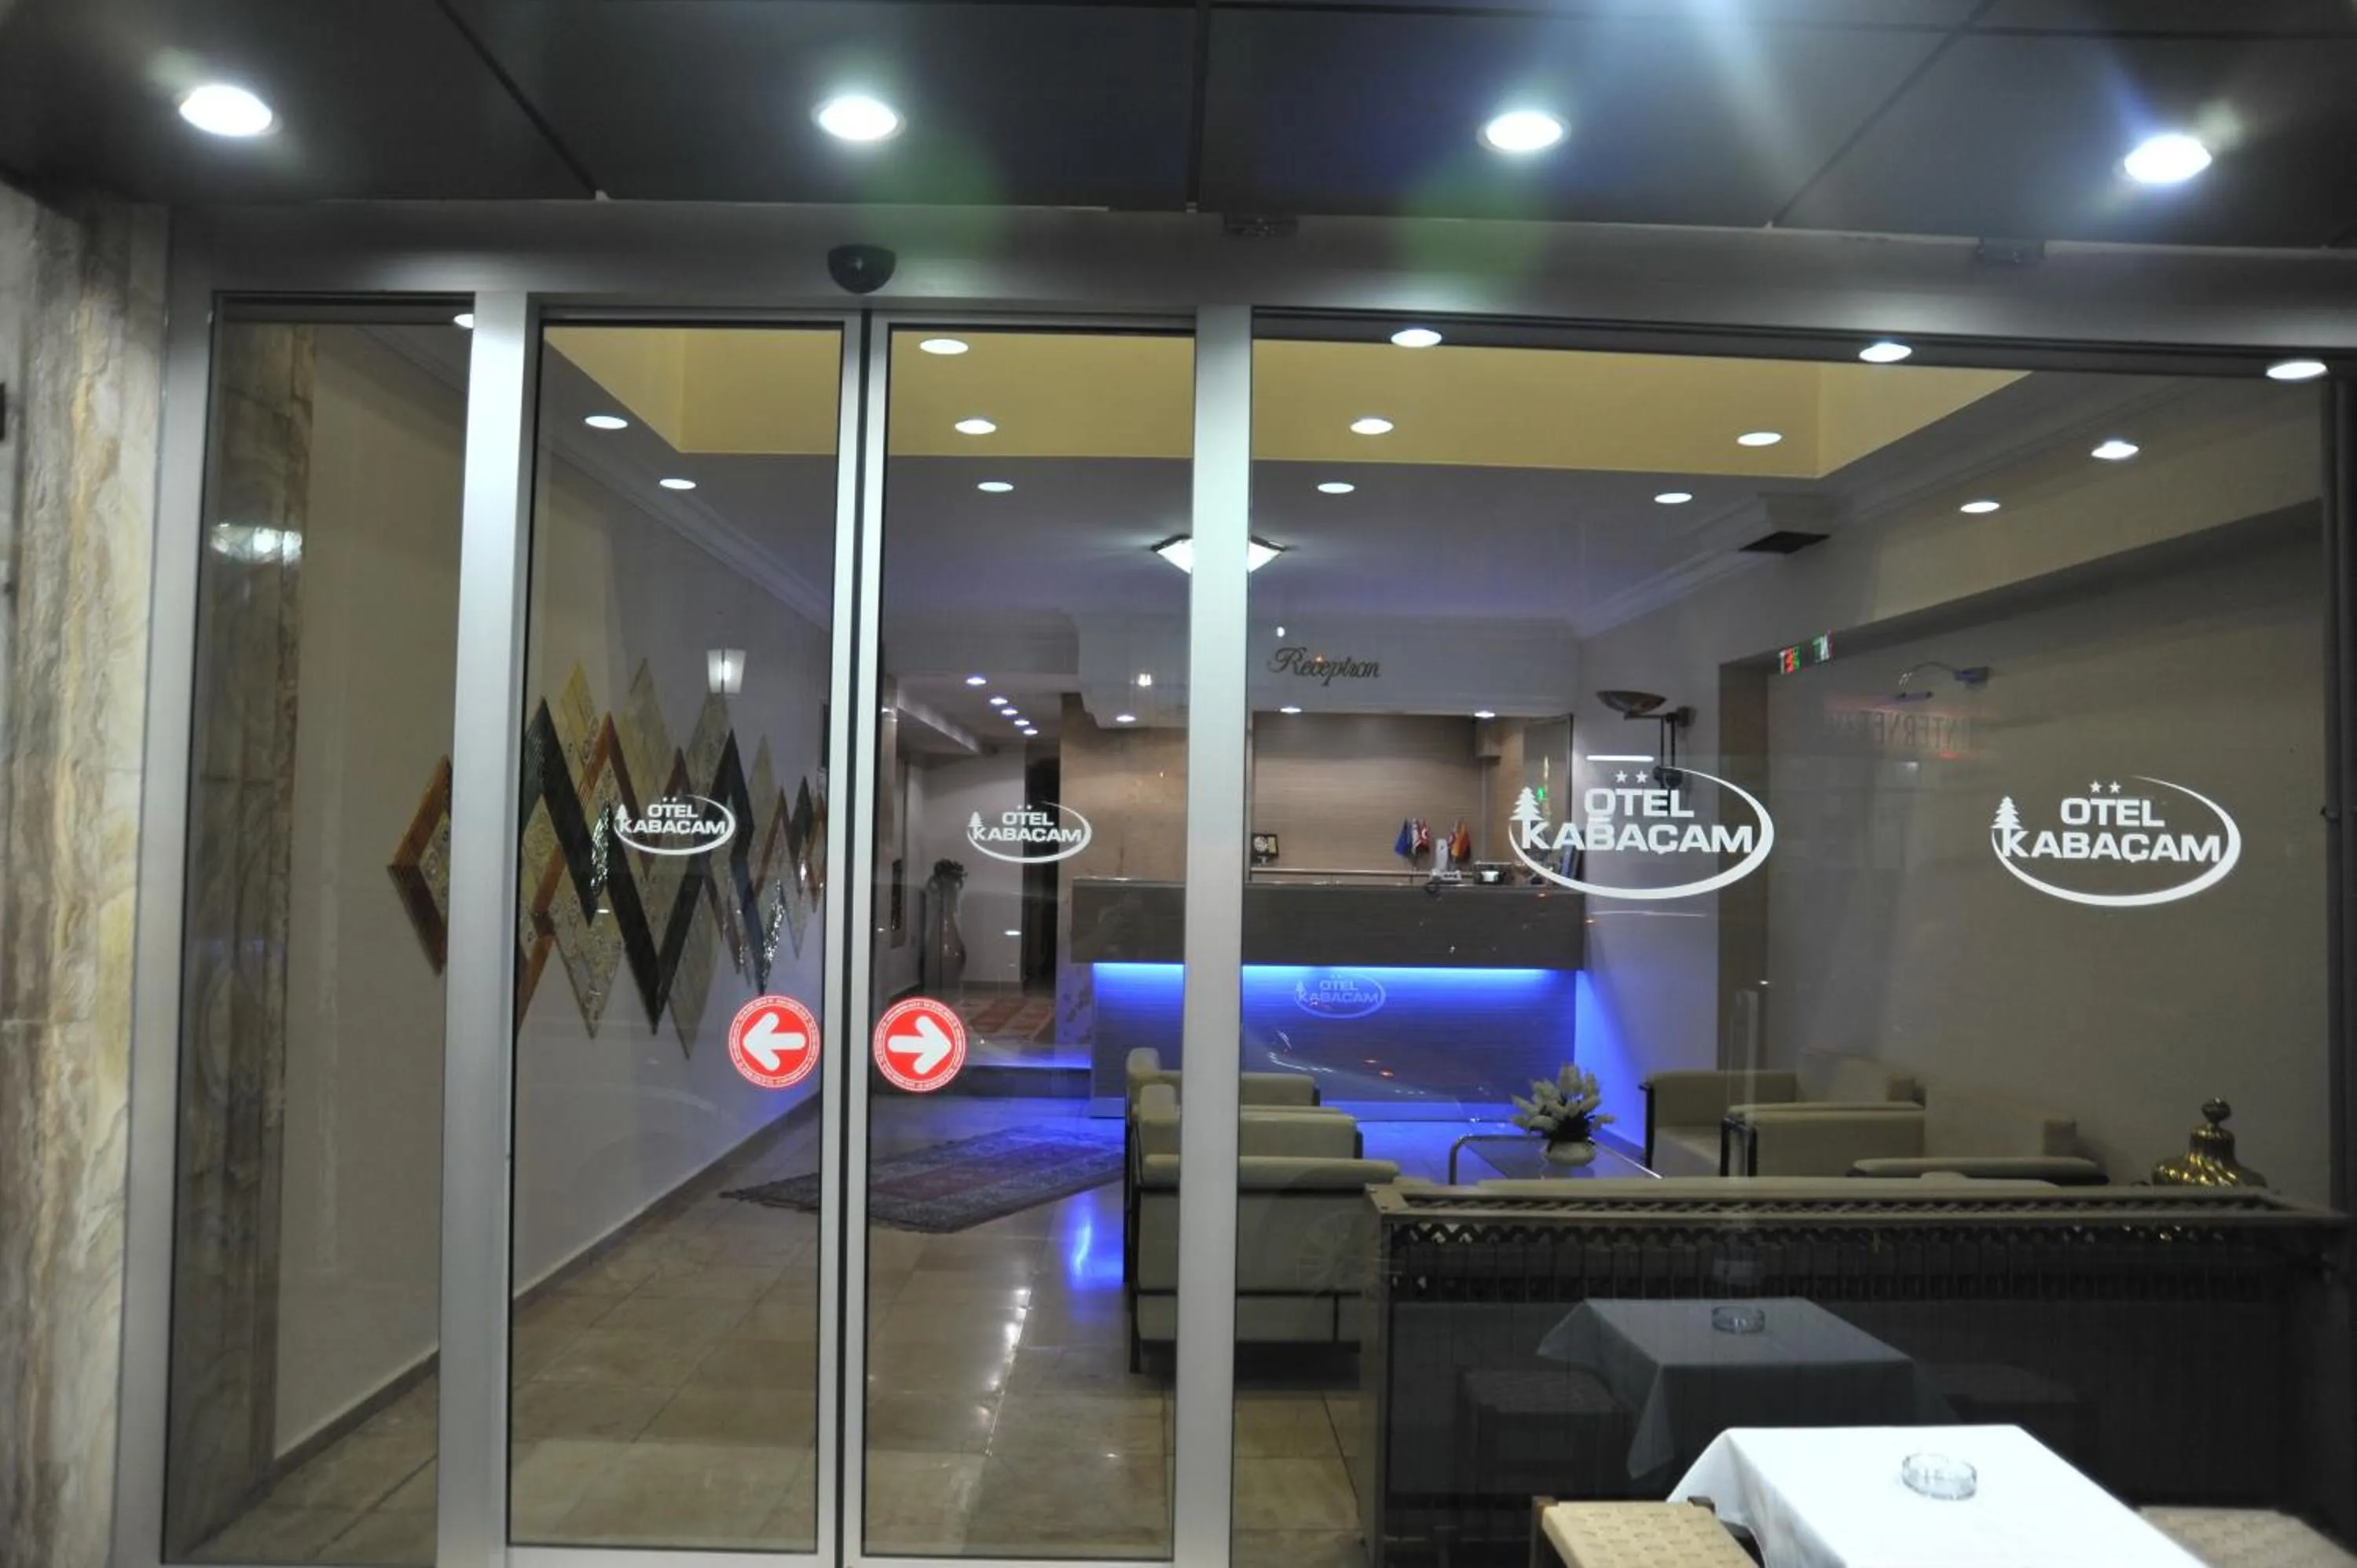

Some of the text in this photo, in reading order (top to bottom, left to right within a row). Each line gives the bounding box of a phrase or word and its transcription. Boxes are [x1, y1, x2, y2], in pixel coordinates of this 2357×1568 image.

[1267, 647, 1380, 687] Reception
[647, 804, 698, 818] OTEL
[1584, 787, 1695, 818] OTEL
[2060, 797, 2165, 827] OTEL
[1002, 811, 1054, 826] OTEL
[1320, 980, 1358, 991] OTEL
